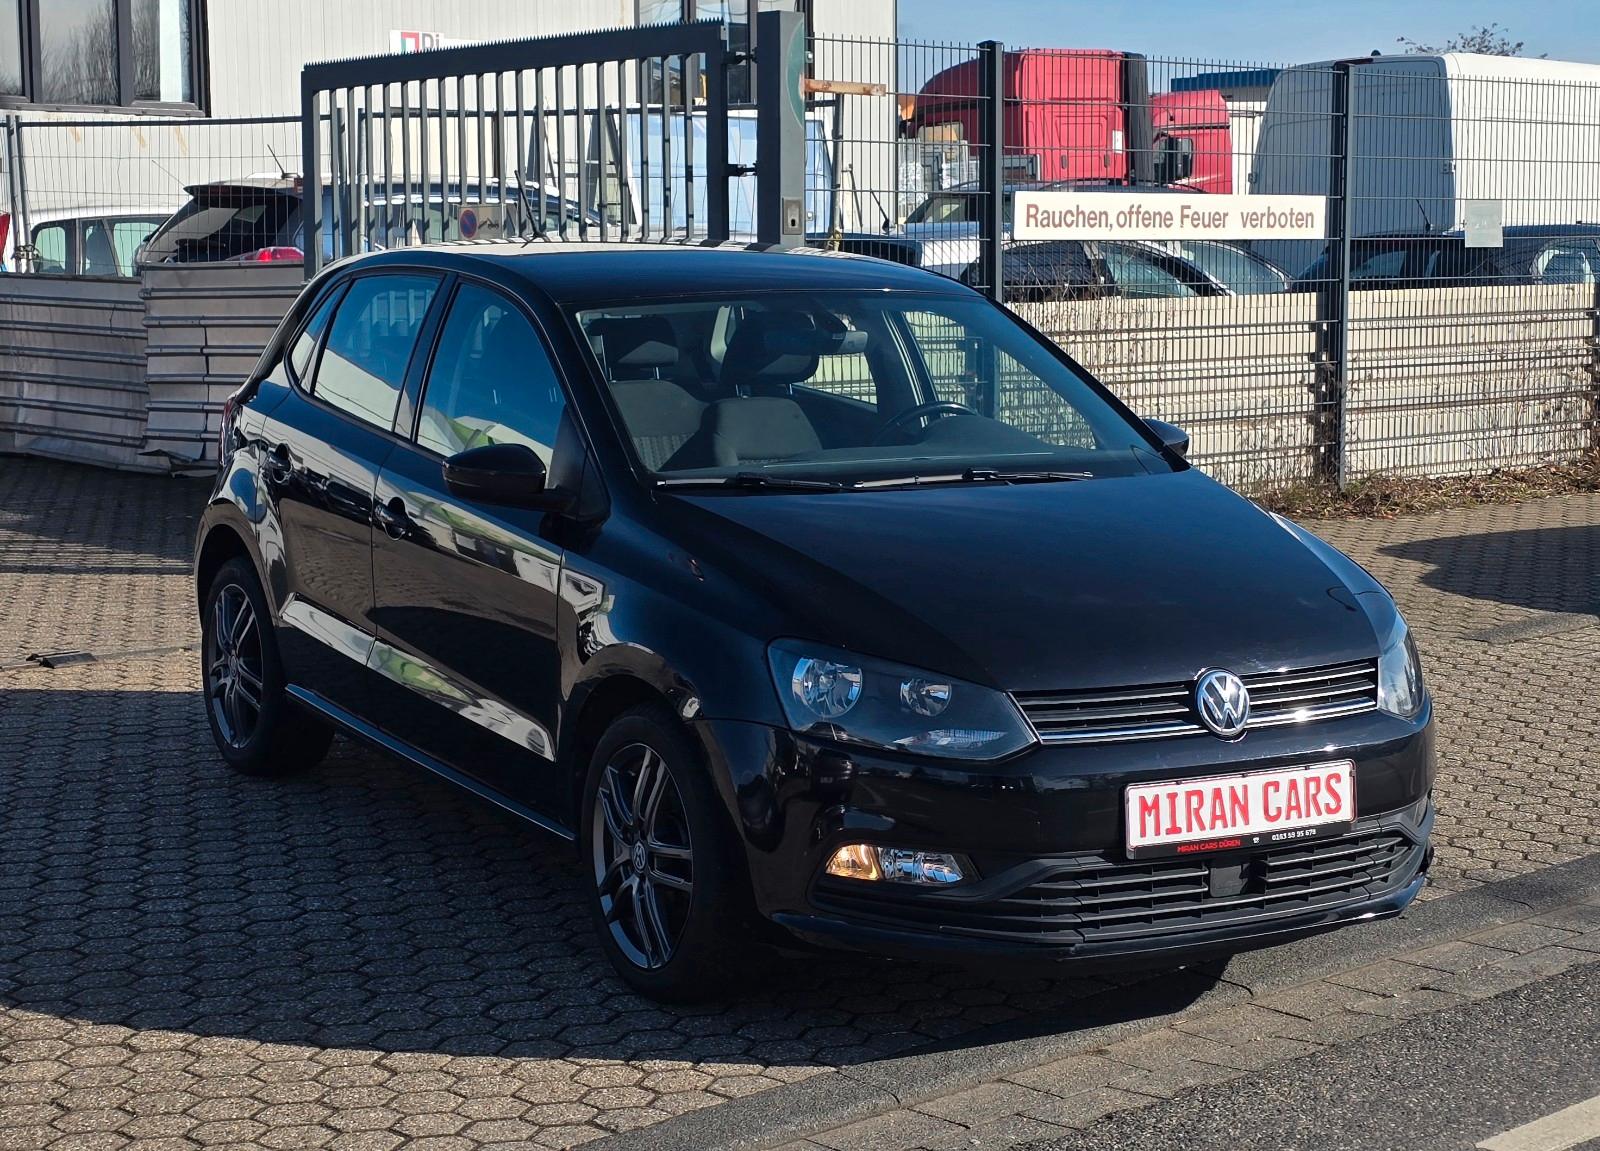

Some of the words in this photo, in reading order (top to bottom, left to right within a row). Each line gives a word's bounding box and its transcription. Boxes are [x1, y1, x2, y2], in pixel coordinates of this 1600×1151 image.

[1025, 204, 1113, 231] Rauchen,
[1115, 204, 1174, 230] offene
[1180, 205, 1229, 230] Feuer
[1240, 206, 1315, 230] verboten
[1138, 784, 1250, 838] MIRAN
[1262, 772, 1343, 823] CARS
[1200, 841, 1218, 850] CARS
